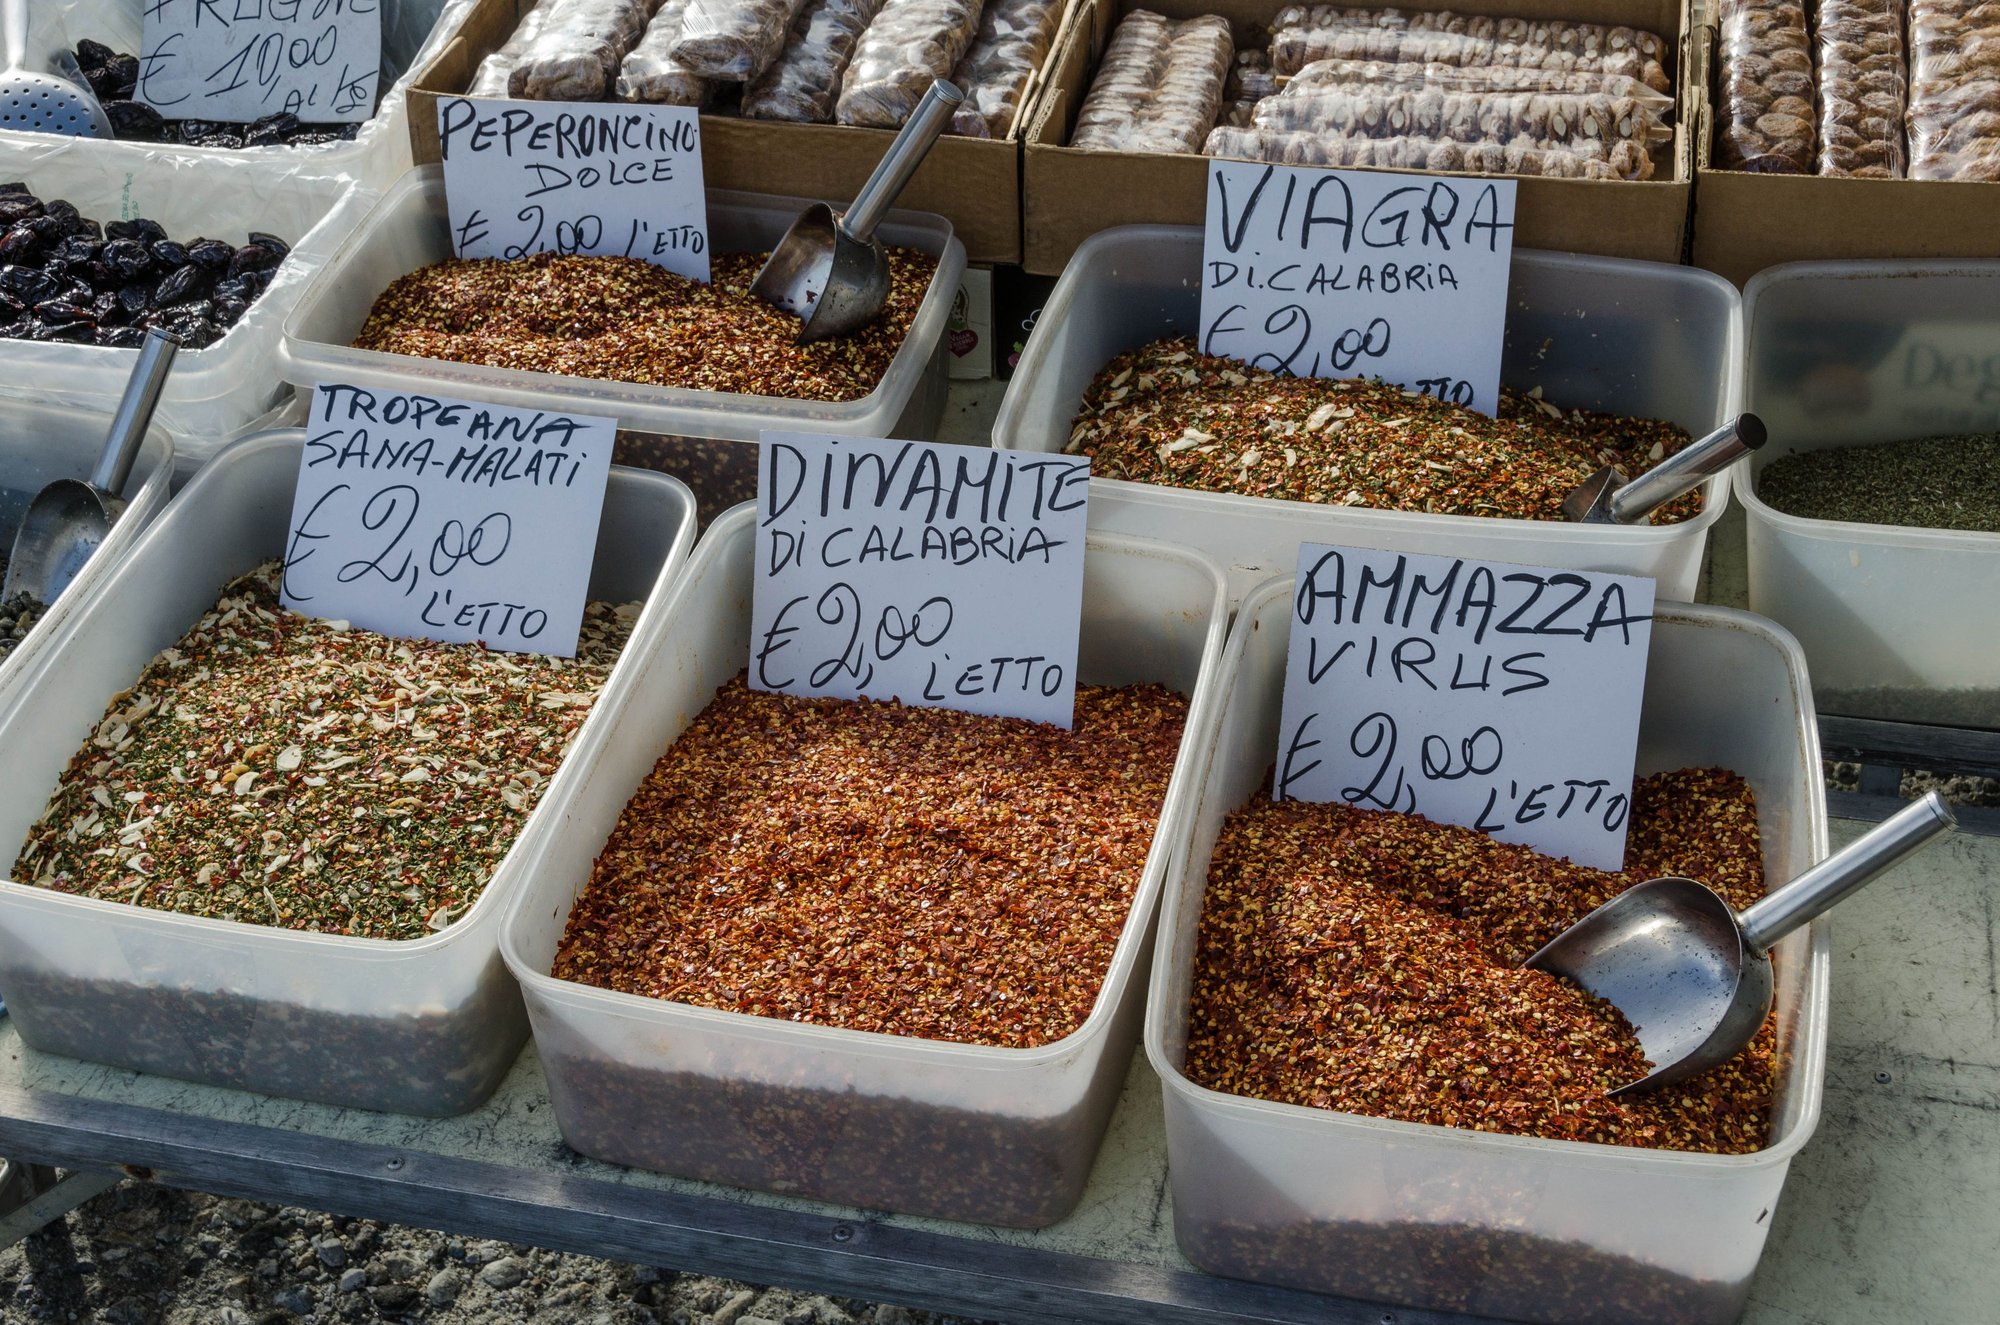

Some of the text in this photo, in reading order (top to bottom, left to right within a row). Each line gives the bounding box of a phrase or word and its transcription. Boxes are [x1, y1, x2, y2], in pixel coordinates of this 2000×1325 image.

[524, 158, 673, 198] DOLCE
[1215, 165, 1514, 254] VIAGRA
[319, 384, 594, 448] TROPEANA
[761, 441, 1092, 527] DINAMITE
[821, 524, 1069, 567] CALABRIA
[421, 589, 548, 639] L'ETTO
[1297, 551, 1653, 645] AMMAZZA
[1308, 635, 1550, 697] VIRUS
[1473, 780, 1629, 833] L'ETTO
